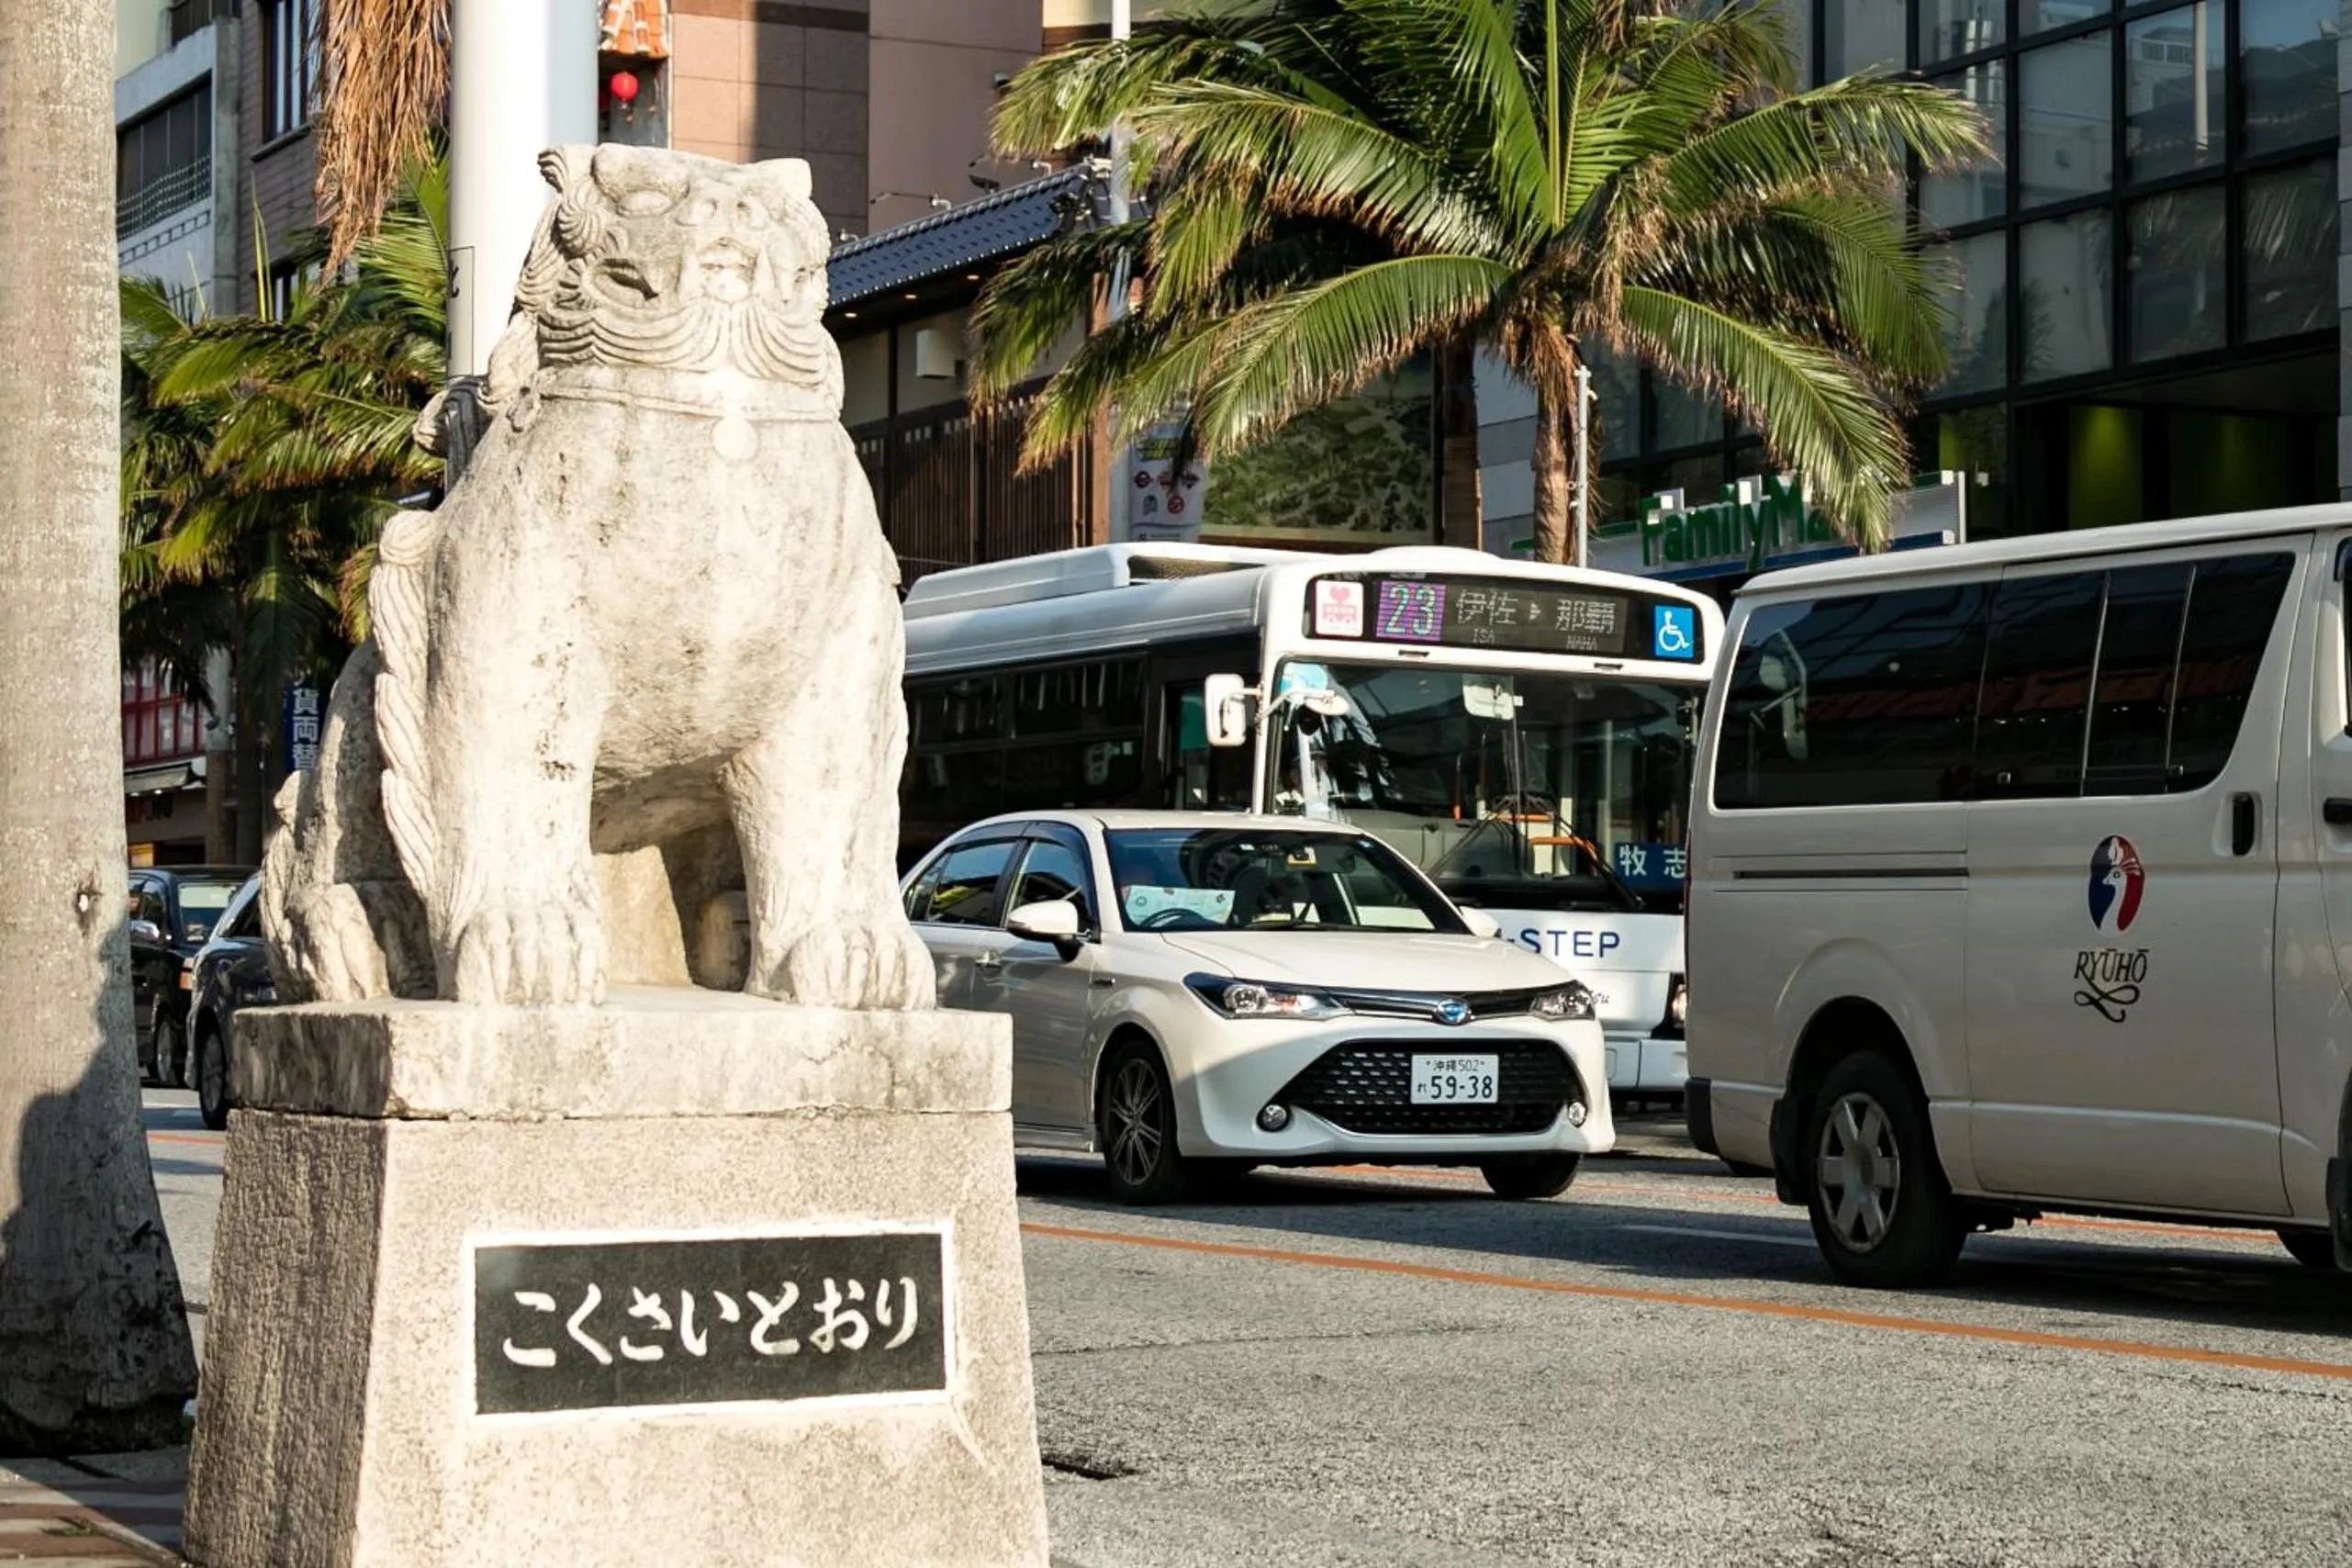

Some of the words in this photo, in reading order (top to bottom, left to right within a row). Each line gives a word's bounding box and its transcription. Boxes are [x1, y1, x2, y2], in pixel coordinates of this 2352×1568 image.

[1641, 472, 1834, 572] FamilyMa
[1384, 585, 1437, 634] 23
[1555, 599, 1616, 634] 那覇
[1473, 628, 1495, 644] ISA
[292, 670, 319, 770] 貨両替
[1618, 844, 1686, 879] 牧志
[1430, 1074, 1493, 1100] 59-38
[502, 1276, 919, 1367] こくさいとおり
